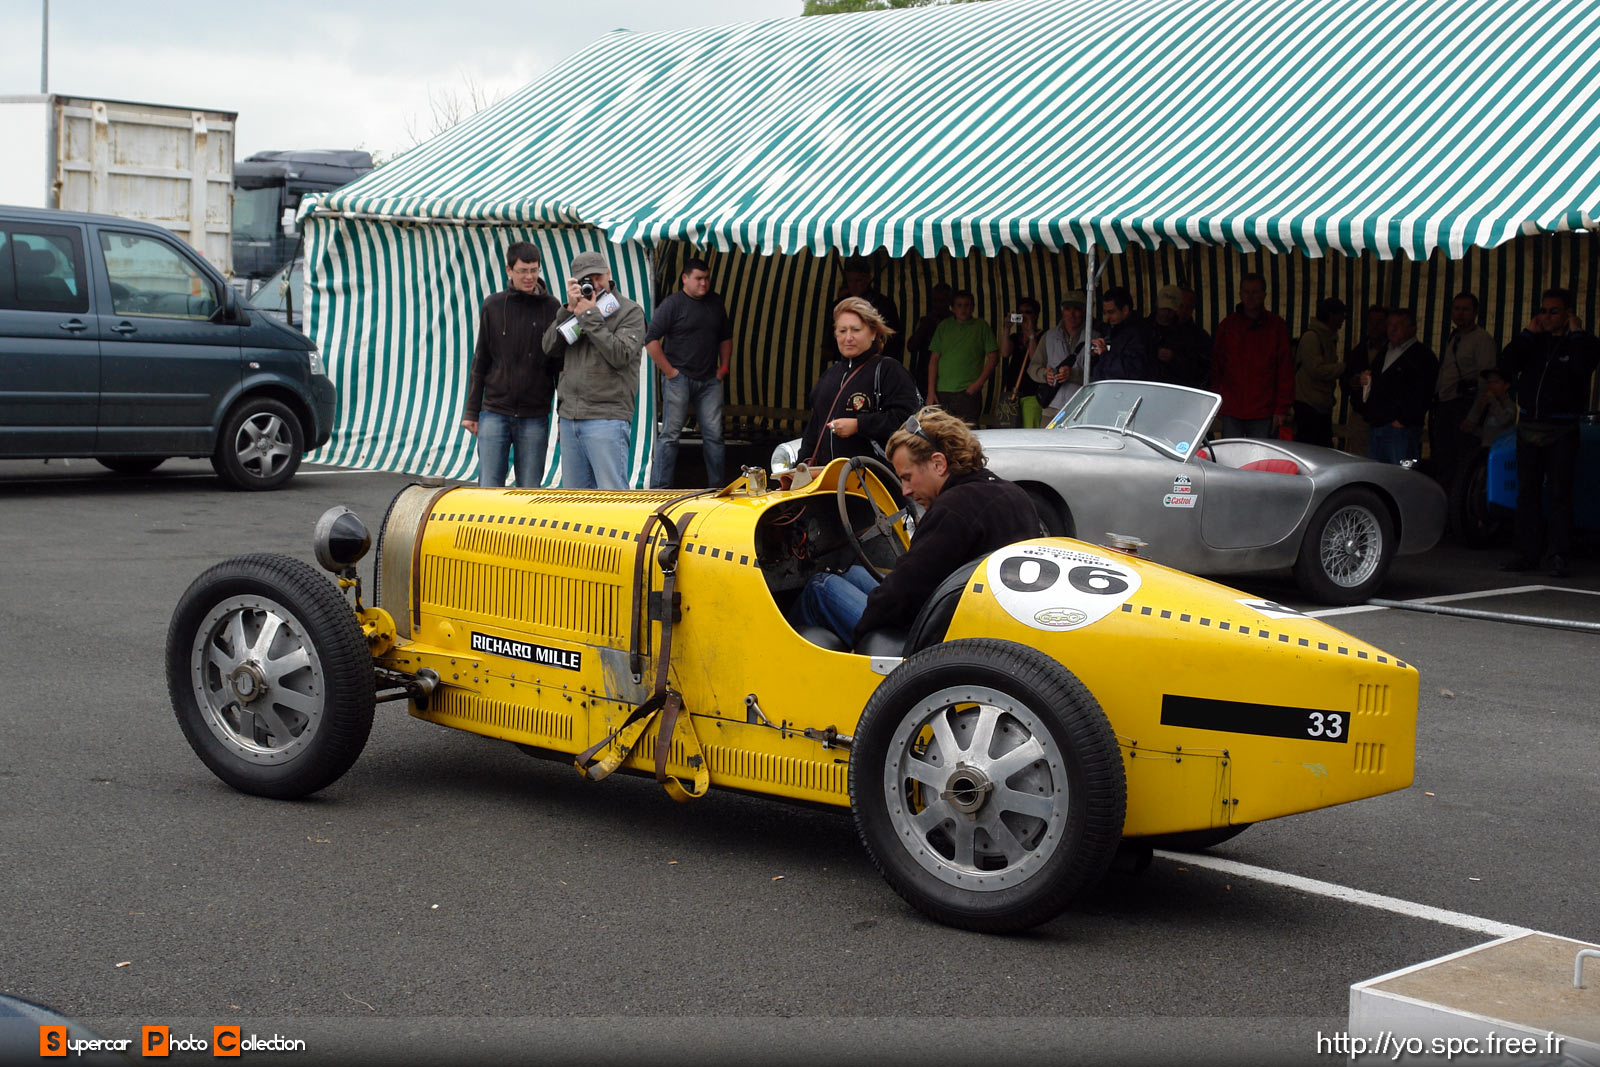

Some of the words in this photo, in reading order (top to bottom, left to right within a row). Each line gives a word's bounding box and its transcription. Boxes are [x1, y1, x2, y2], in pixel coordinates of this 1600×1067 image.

[1171, 496, 1192, 504] Castrol
[1000, 556, 1129, 595] 06
[472, 634, 532, 659] RICHARD
[535, 647, 580, 668] MILLE
[1307, 712, 1343, 738] 33
